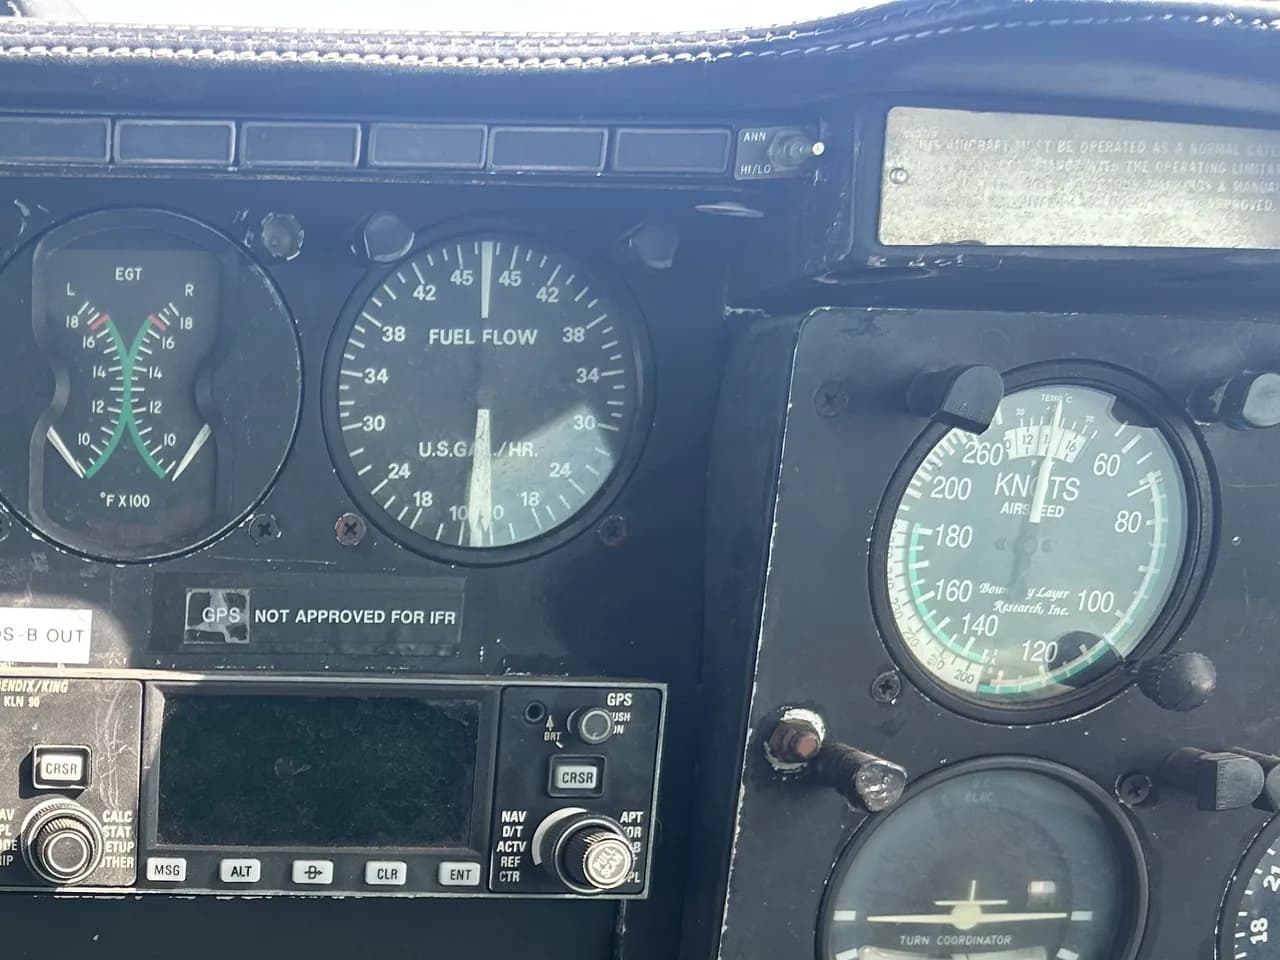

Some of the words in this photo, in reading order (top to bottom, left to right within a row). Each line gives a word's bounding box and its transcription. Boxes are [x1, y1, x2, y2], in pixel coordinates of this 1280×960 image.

[115, 267, 142, 281] EGT
[450, 270, 474, 286] 45
[498, 270, 521, 286] 45
[67, 283, 75, 295] L
[185, 285, 194, 296] R
[413, 286, 436, 301] 42
[536, 286, 560, 303] 42
[381, 326, 406, 342] 38
[428, 329, 475, 345] FUEL
[482, 329, 538, 345] FLOW
[562, 327, 585, 343] 38
[1094, 454, 1120, 477] 60
[931, 478, 971, 500] 200
[1115, 511, 1141, 533] 80
[936, 525, 972, 548] 180
[936, 580, 972, 601] 160
[1078, 591, 1114, 613] 100
[202, 608, 240, 622] GPS
[255, 610, 290, 623] NOT
[295, 610, 385, 624] APPROVED
[391, 610, 425, 624] FOR
[430, 611, 456, 625] IFR
[962, 615, 998, 636] 140
[47, 628, 85, 643] OUT
[1022, 641, 1058, 662] 120
[4, 697, 24, 708] KLN
[28, 697, 40, 708] 90
[607, 693, 632, 706] GPS
[46, 763, 78, 775] CRSR
[562, 772, 593, 783] CRSR
[103, 811, 132, 822] CALC
[502, 811, 526, 823] NAV
[154, 864, 180, 876] MSG
[231, 865, 252, 878] ALT
[377, 868, 398, 880] CLR
[450, 868, 472, 881] ENT
[900, 935, 929, 945] TURN
[936, 935, 1012, 945] COORDINATOR
